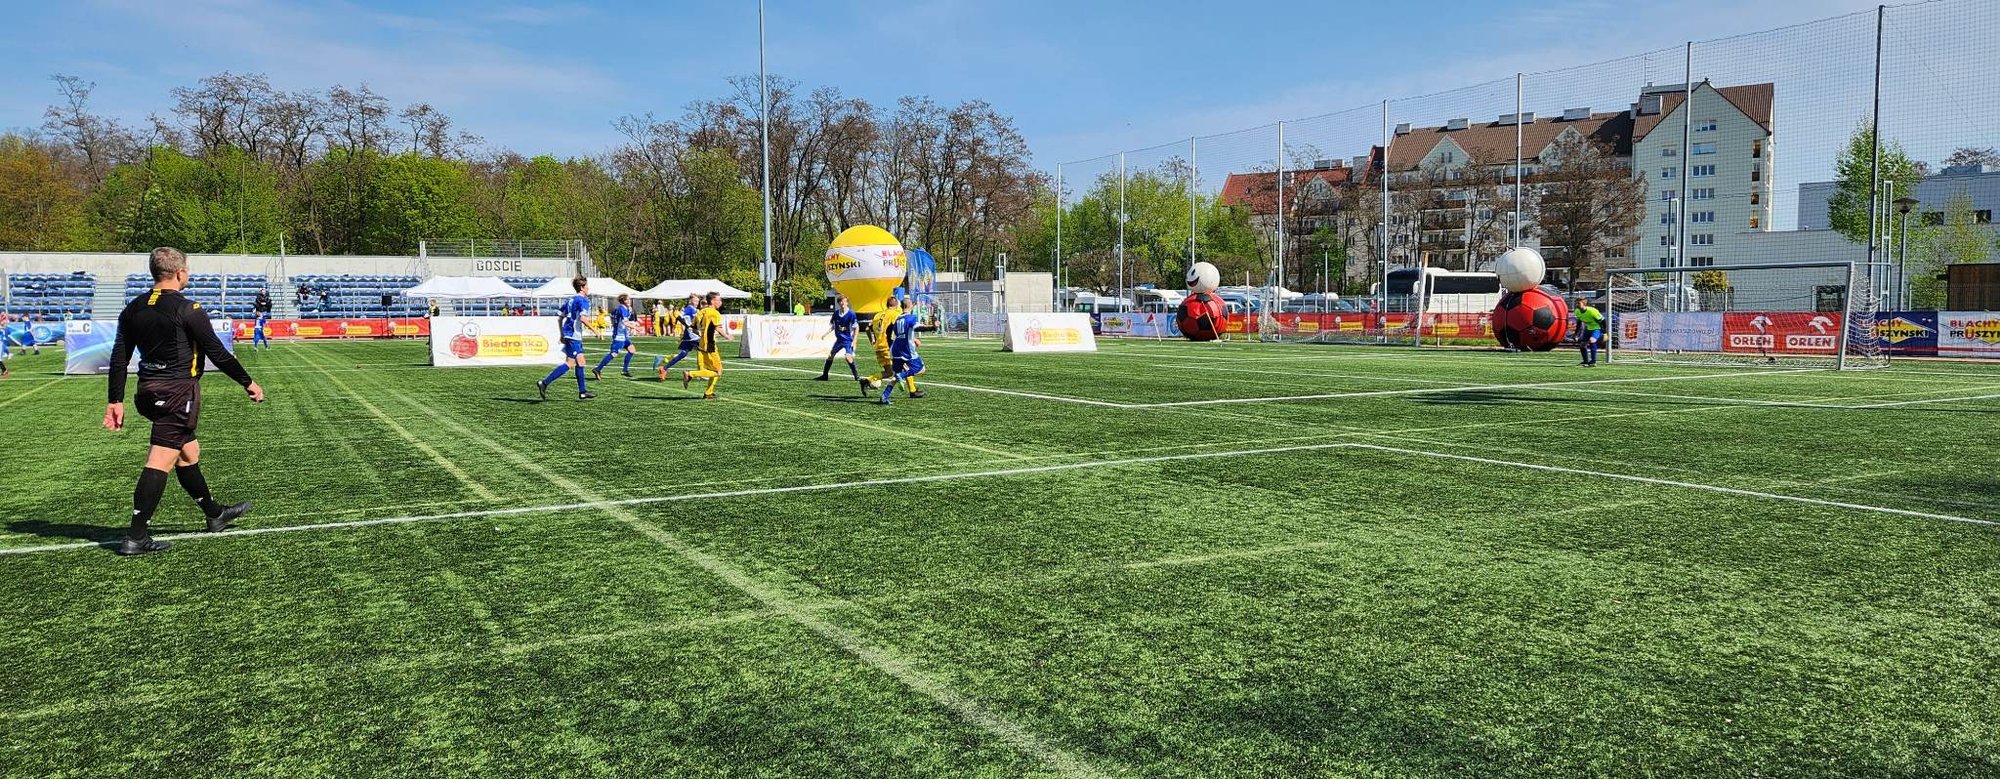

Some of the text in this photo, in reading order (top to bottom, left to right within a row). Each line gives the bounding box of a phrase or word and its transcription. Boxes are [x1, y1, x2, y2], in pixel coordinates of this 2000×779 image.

[82, 322, 90, 333] C
[222, 322, 229, 332] C
[1733, 336, 1771, 346] ORLEN
[1789, 337, 1832, 347] ORLEN
